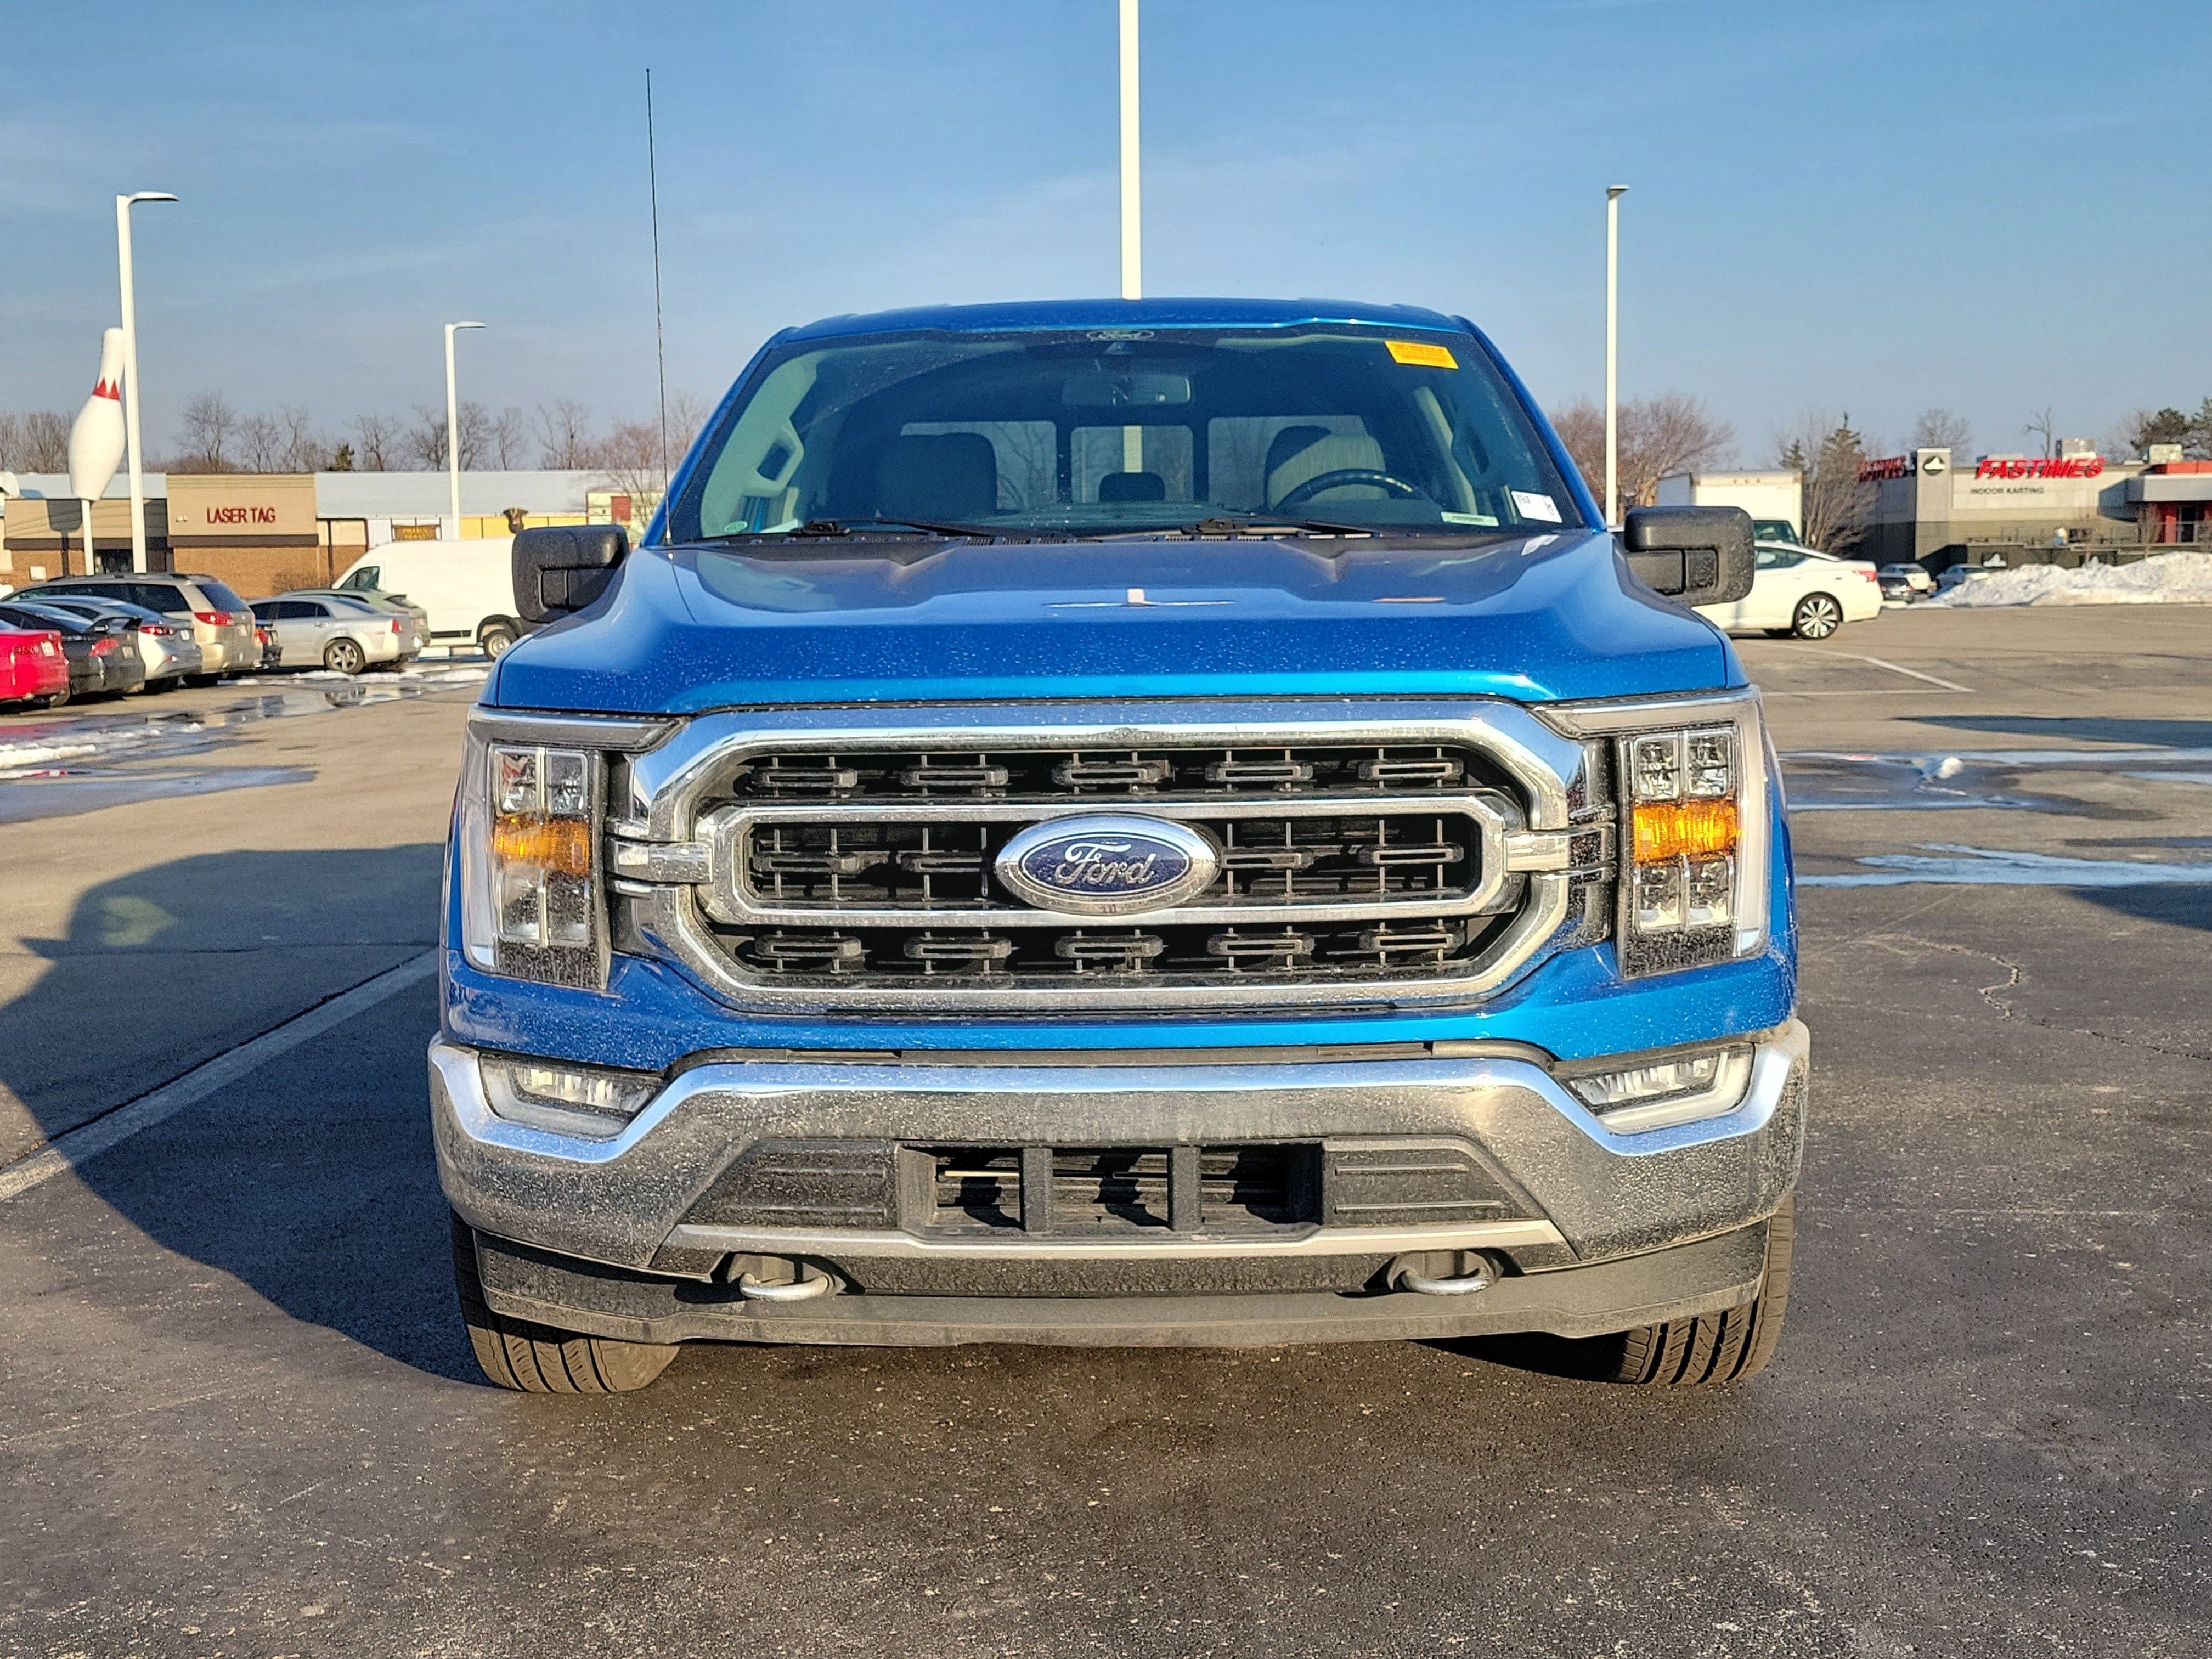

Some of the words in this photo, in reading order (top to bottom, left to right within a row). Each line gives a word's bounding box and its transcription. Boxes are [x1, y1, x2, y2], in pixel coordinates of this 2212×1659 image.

[1976, 458, 2107, 479] FASTIMES
[207, 507, 247, 524] LASER
[250, 507, 276, 523] TAG
[1054, 841, 1156, 885] Ford
